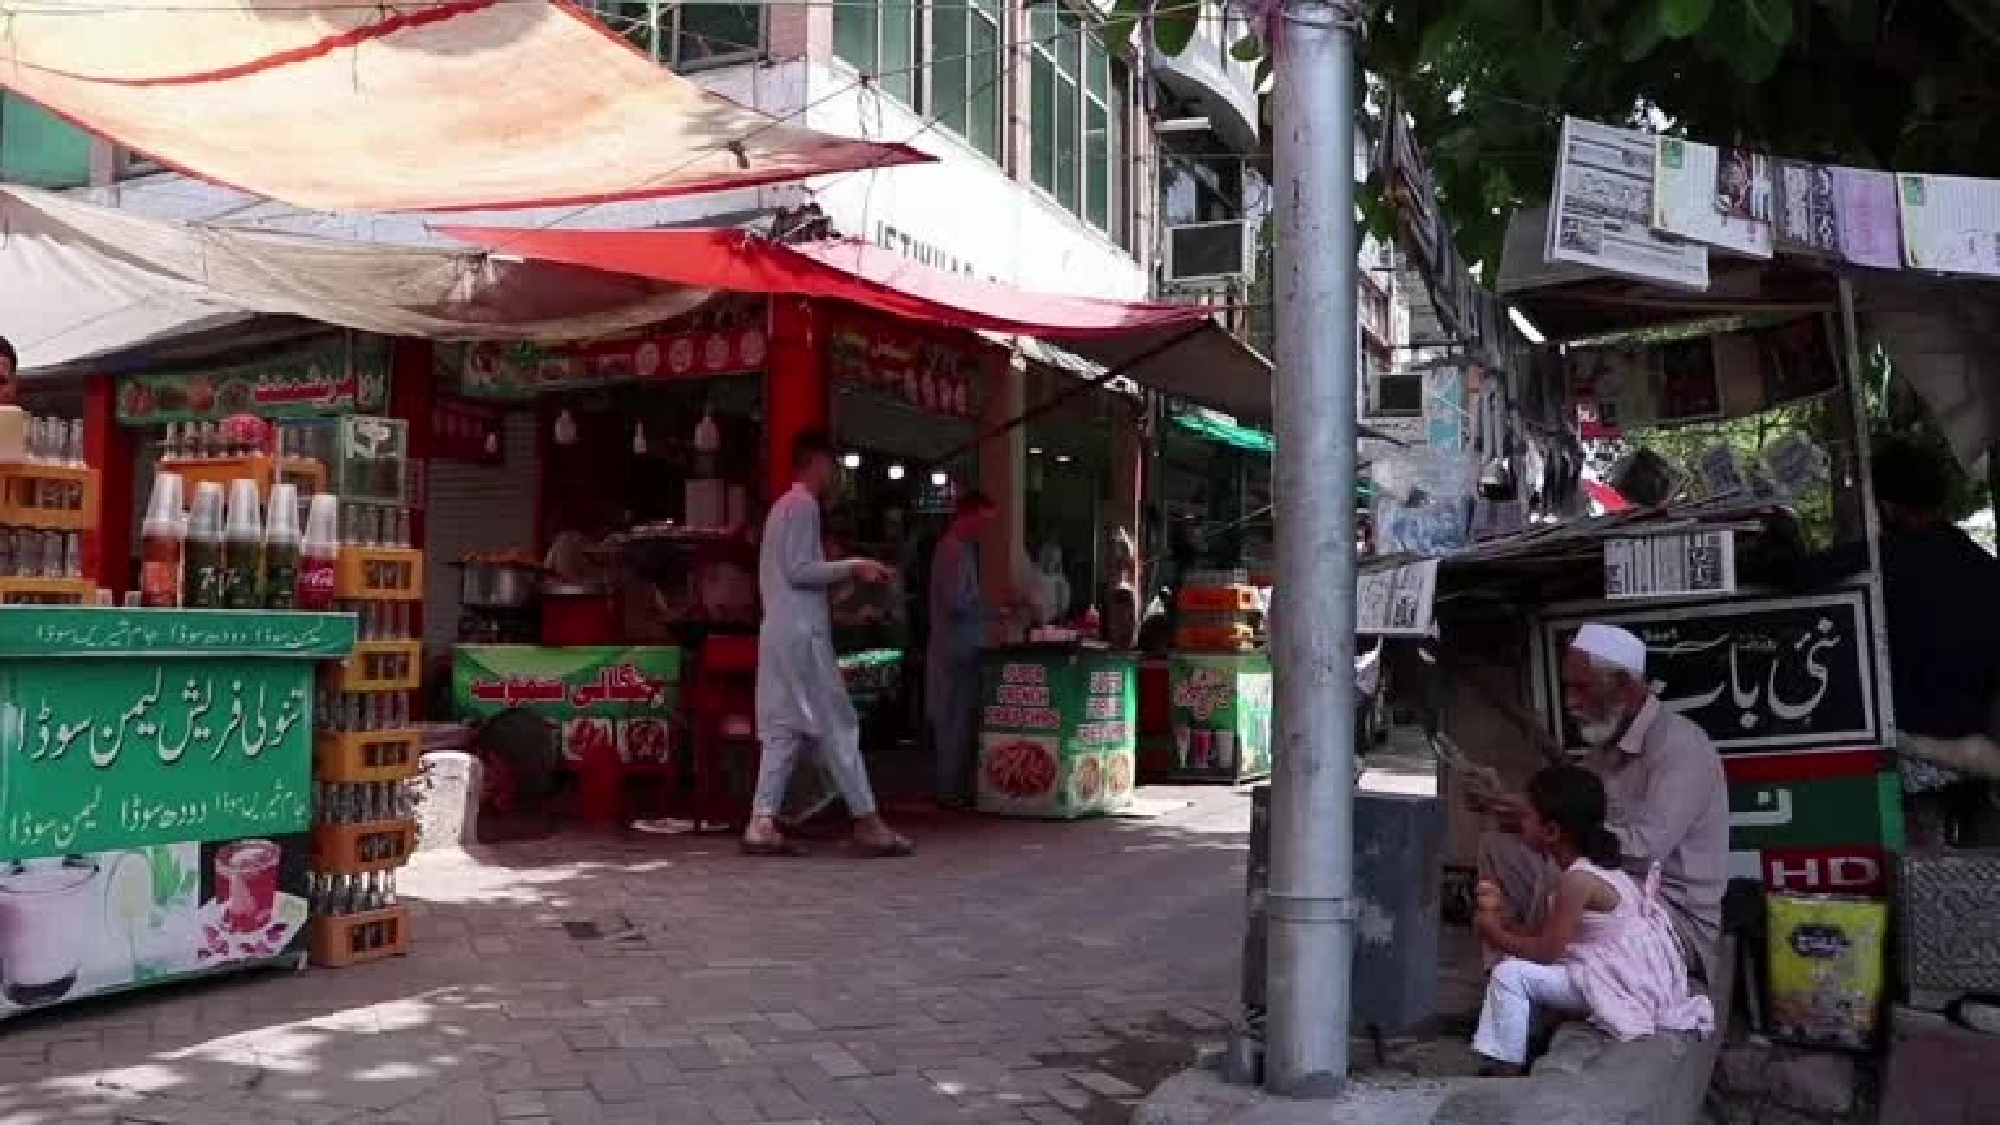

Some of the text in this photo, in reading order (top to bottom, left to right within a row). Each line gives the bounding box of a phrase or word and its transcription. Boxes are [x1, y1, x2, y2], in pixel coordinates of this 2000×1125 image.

[17, 695, 92, 761] سوڈا
[90, 665, 162, 768] لیمن
[157, 677, 242, 763] فریش
[1770, 856, 1882, 887] HD
